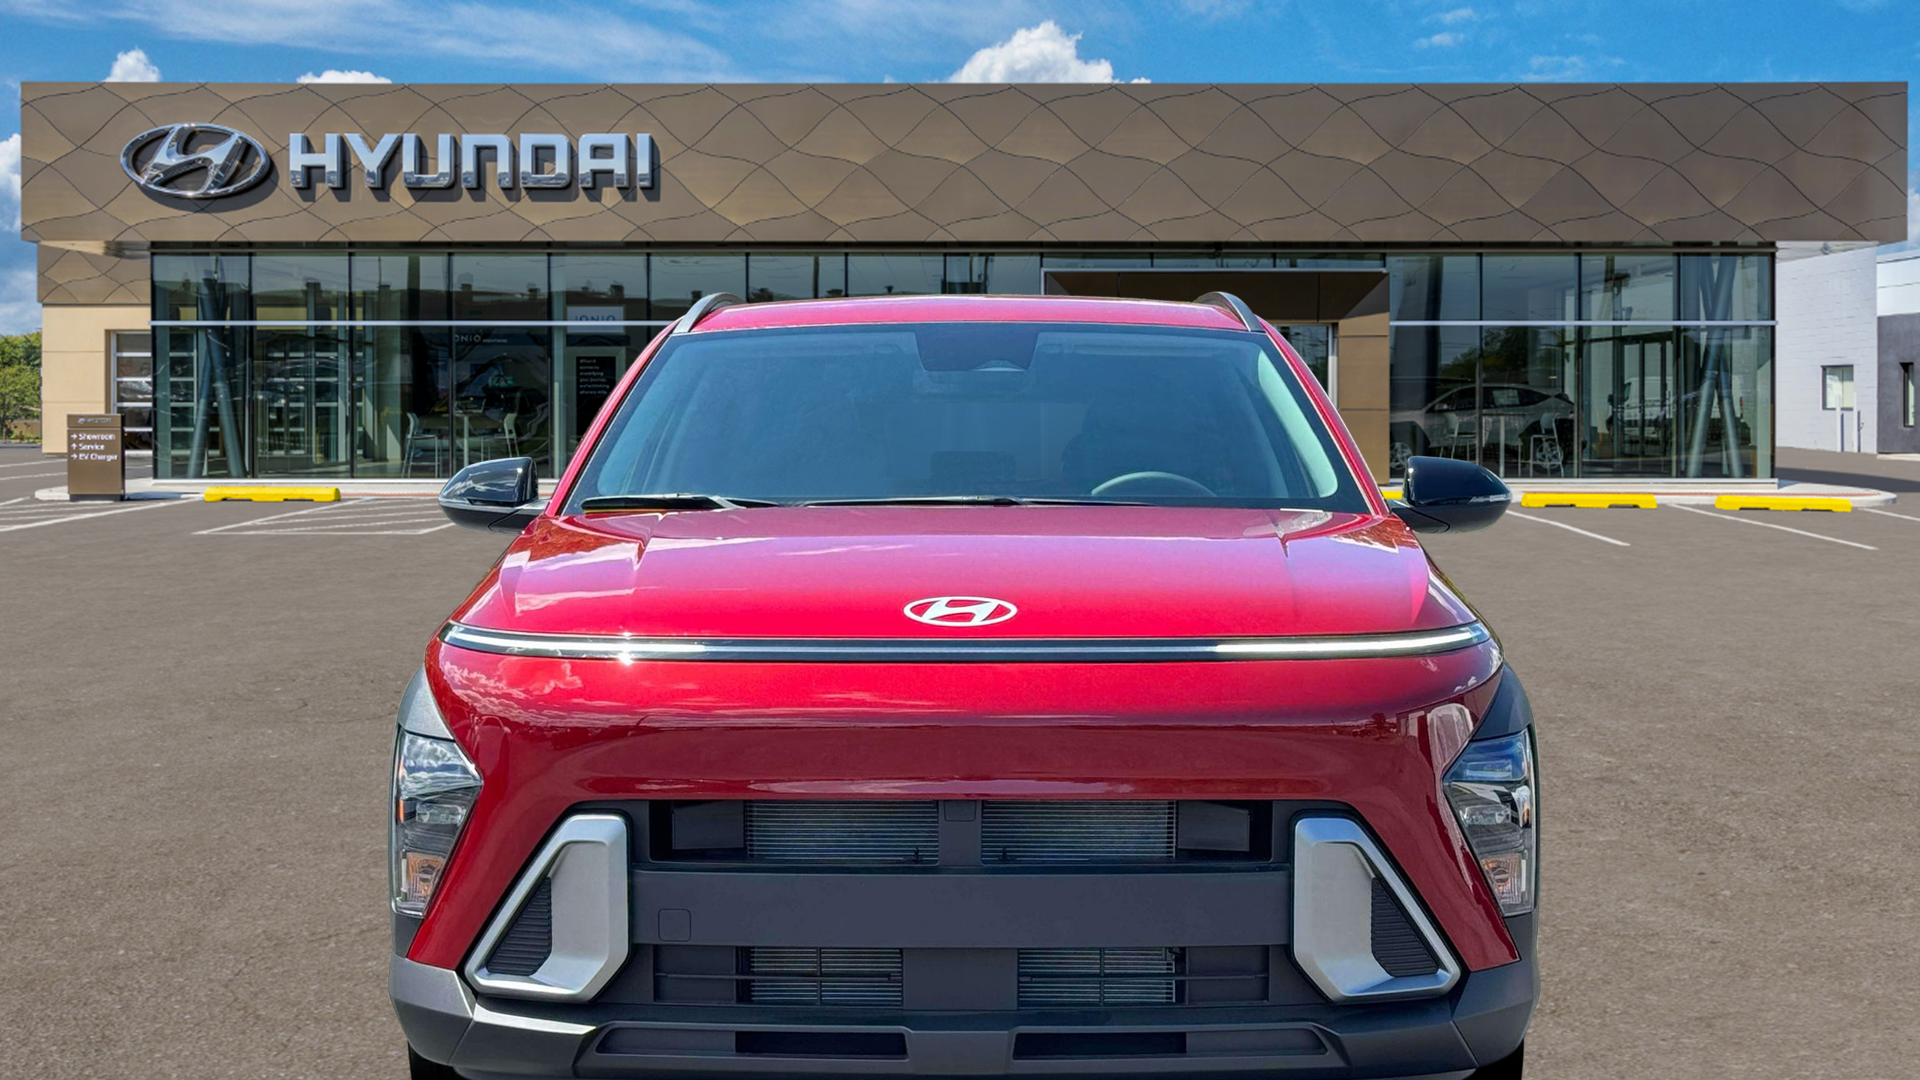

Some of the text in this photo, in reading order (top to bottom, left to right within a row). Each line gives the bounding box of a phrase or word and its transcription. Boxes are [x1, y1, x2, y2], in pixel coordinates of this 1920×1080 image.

[289, 133, 653, 189] HYUNDAI
[78, 433, 116, 441] Showroom
[78, 443, 105, 451] Service
[78, 453, 118, 462] EV Charger
